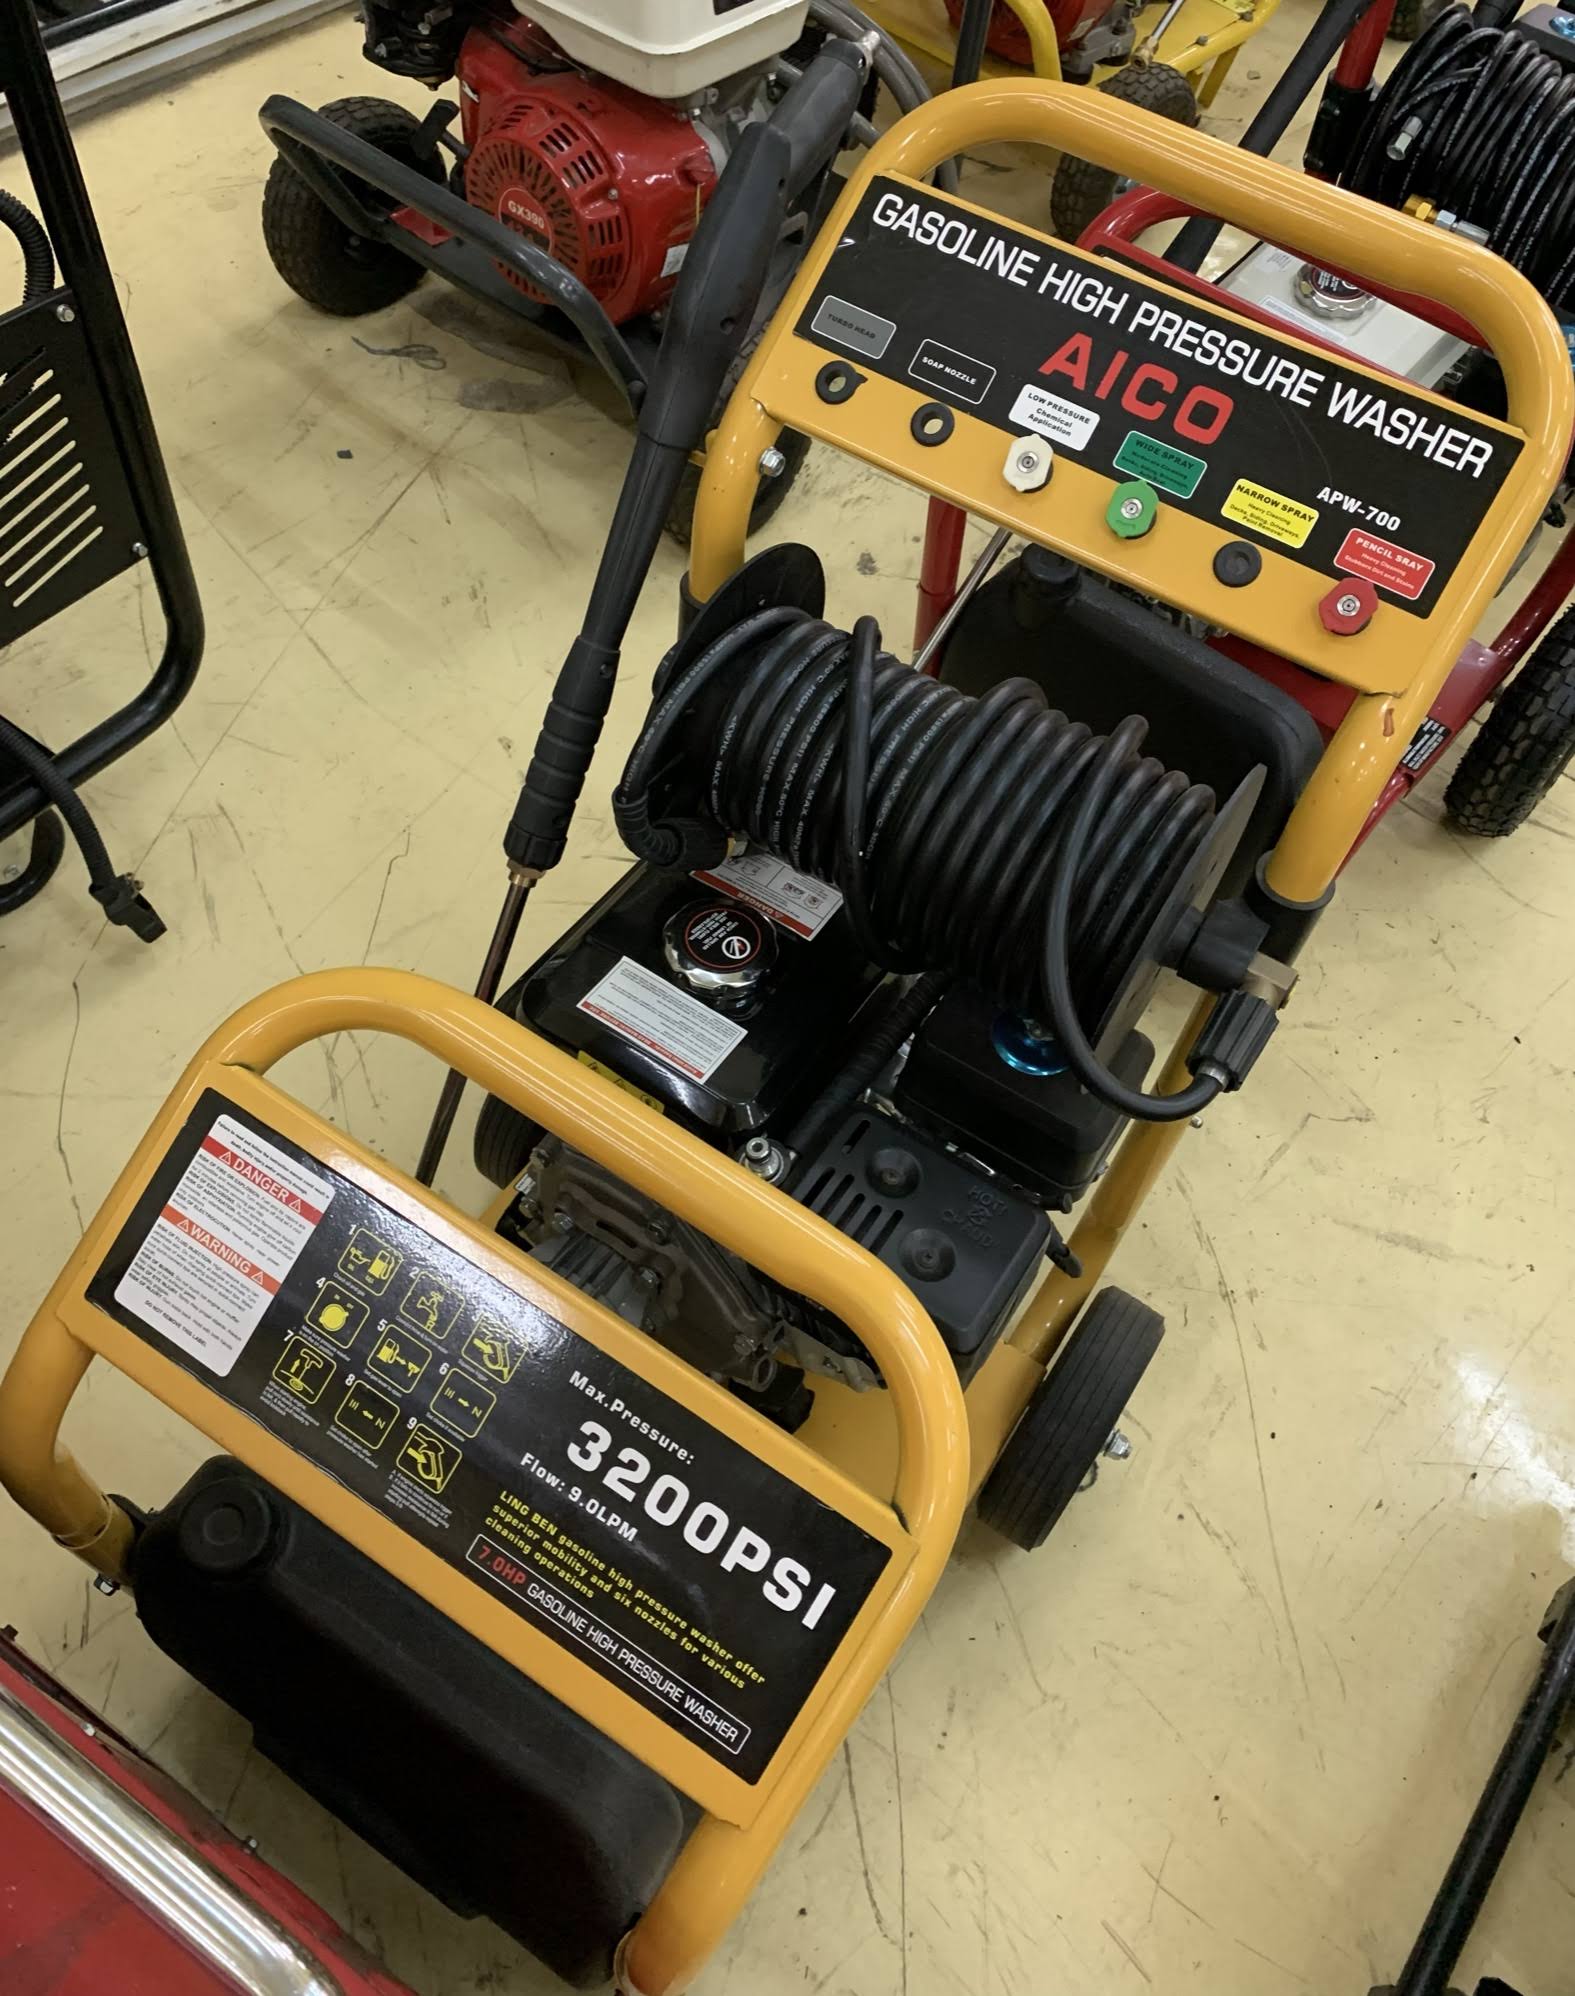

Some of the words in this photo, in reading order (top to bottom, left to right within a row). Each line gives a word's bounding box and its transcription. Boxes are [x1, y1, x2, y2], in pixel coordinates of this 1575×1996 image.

[507, 199, 544, 229] GX390
[873, 193, 1039, 285] GASOLINE
[1038, 262, 1128, 323] HIGH
[1128, 301, 1324, 406] PRESSURE
[1327, 382, 1492, 477] WASHER
[922, 356, 944, 369] SOAP
[943, 366, 976, 384] NOZZLE
[1040, 333, 1232, 443] AICO
[1027, 391, 1046, 405] LOW
[1046, 398, 1091, 425] PRESSURE
[1035, 404, 1073, 431] Chemical
[1026, 409, 1072, 441] Application
[1134, 438, 1160, 455] WIDE
[1159, 450, 1194, 470] SPRAY
[1235, 483, 1280, 508] NARROW
[1280, 503, 1314, 523] SPRAY
[1247, 502, 1265, 514] Heavy
[1264, 510, 1291, 526] Cleaning
[1316, 486, 1400, 530] APW-700
[1354, 534, 1395, 561] PENCIL
[1394, 552, 1424, 573] SRAY
[710, 759, 723, 785] MAX
[735, 890, 775, 915] DANGER
[230, 1157, 291, 1203] DANGER
[348, 1224, 357, 1236] 1
[186, 1223, 254, 1275] WARNING
[316, 1277, 326, 1288] 4
[408, 1266, 420, 1280] 2
[284, 1329, 294, 1342] 7
[377, 1318, 388, 1332] 5
[345, 1374, 356, 1386] 8
[438, 1362, 450, 1376] 6
[406, 1416, 418, 1430] 9
[569, 1370, 693, 1464] Max.Pressure:
[520, 1452, 565, 1491] Flow:
[568, 1486, 637, 1541] 9.0LPM
[567, 1421, 834, 1627] 3200PSI
[485, 1516, 531, 1554] cleaning
[533, 1551, 593, 1598] operations
[492, 1504, 540, 1539] superior
[542, 1540, 588, 1576] mobility
[589, 1574, 612, 1592] and
[613, 1591, 631, 1607] six
[634, 1606, 677, 1639] nozzles
[679, 1636, 698, 1653] for
[701, 1653, 744, 1688] various
[499, 1490, 529, 1515] LING
[530, 1512, 557, 1535] BEN
[558, 1534, 605, 1570] gasoline
[608, 1567, 632, 1590] high
[634, 1589, 687, 1629] pressure
[690, 1627, 732, 1659] washer
[735, 1660, 765, 1683] offer
[479, 1545, 525, 1584] 7.0HP
[527, 1582, 587, 1632] GASOLINE
[586, 1625, 618, 1654] HIGH
[617, 1648, 684, 1702] PRESSURE
[684, 1695, 738, 1742] WASHER
